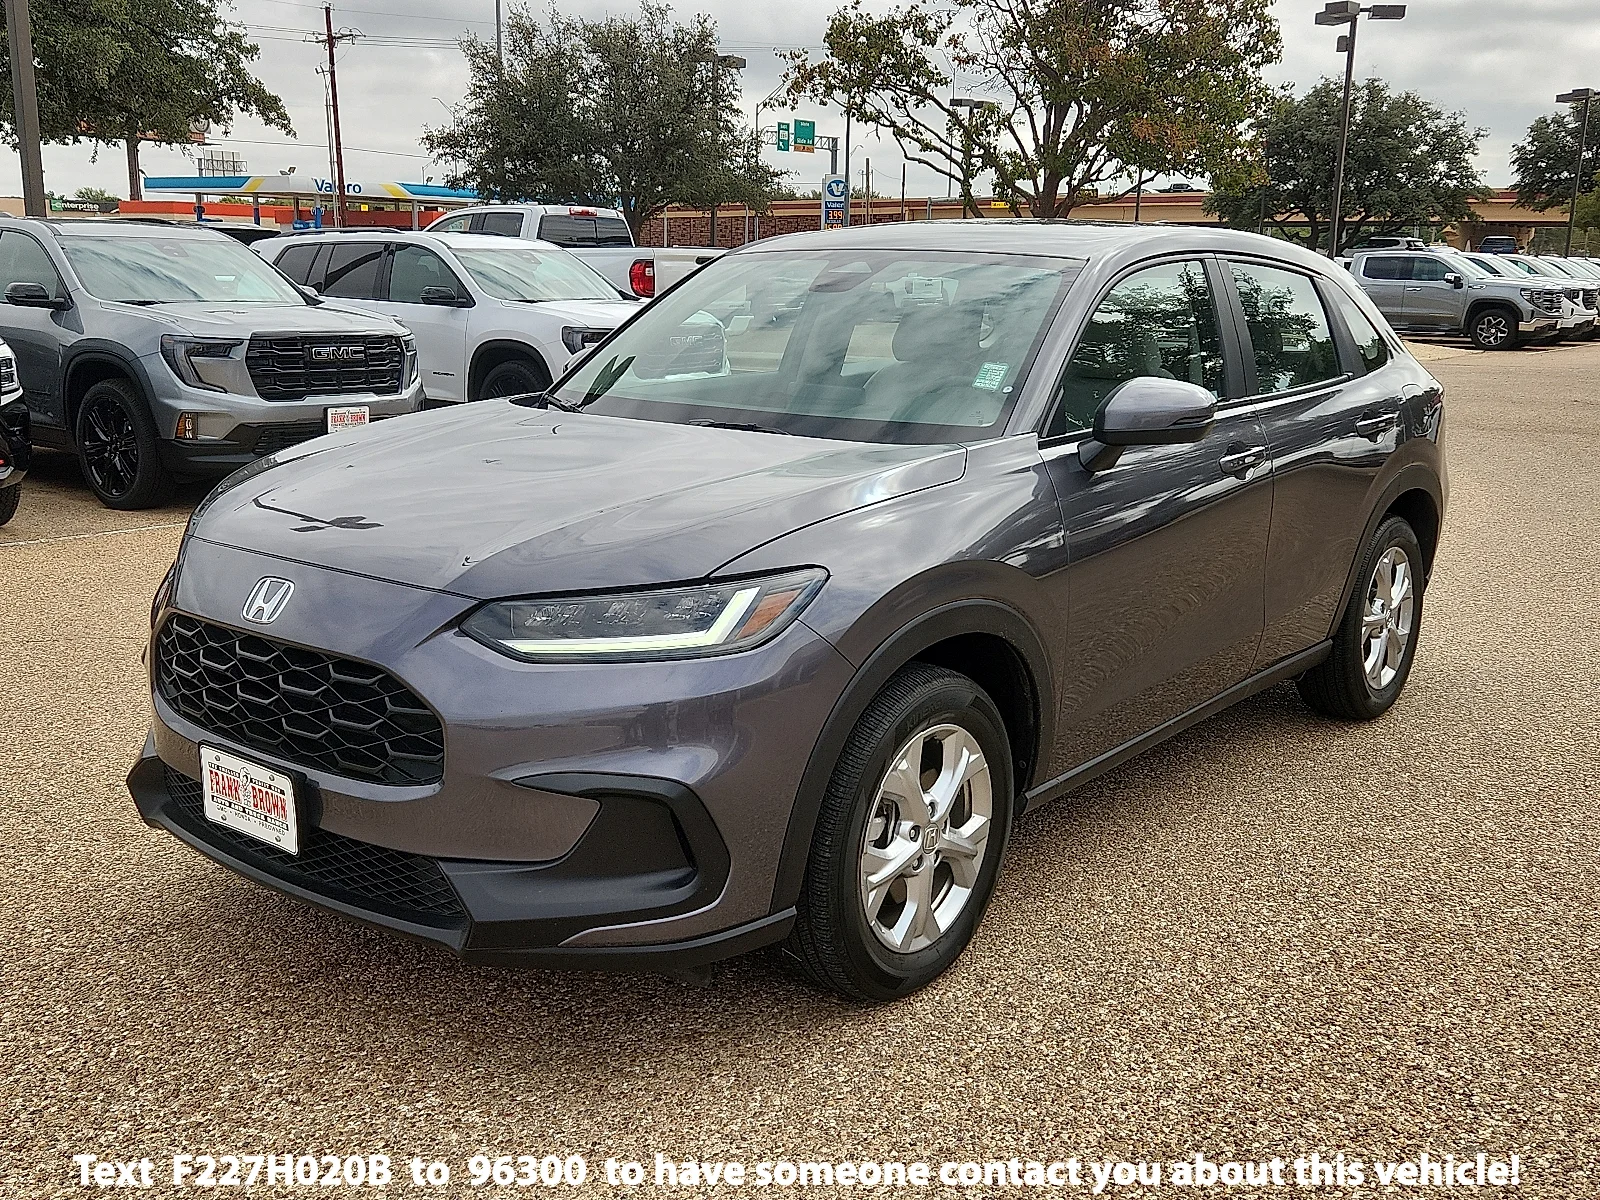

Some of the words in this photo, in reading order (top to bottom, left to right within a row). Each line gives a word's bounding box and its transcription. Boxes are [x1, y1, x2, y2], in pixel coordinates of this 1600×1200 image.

[313, 178, 363, 194] Valro
[312, 346, 366, 360] GMC
[208, 769, 241, 803] FRANK
[251, 785, 288, 821] BROWN
